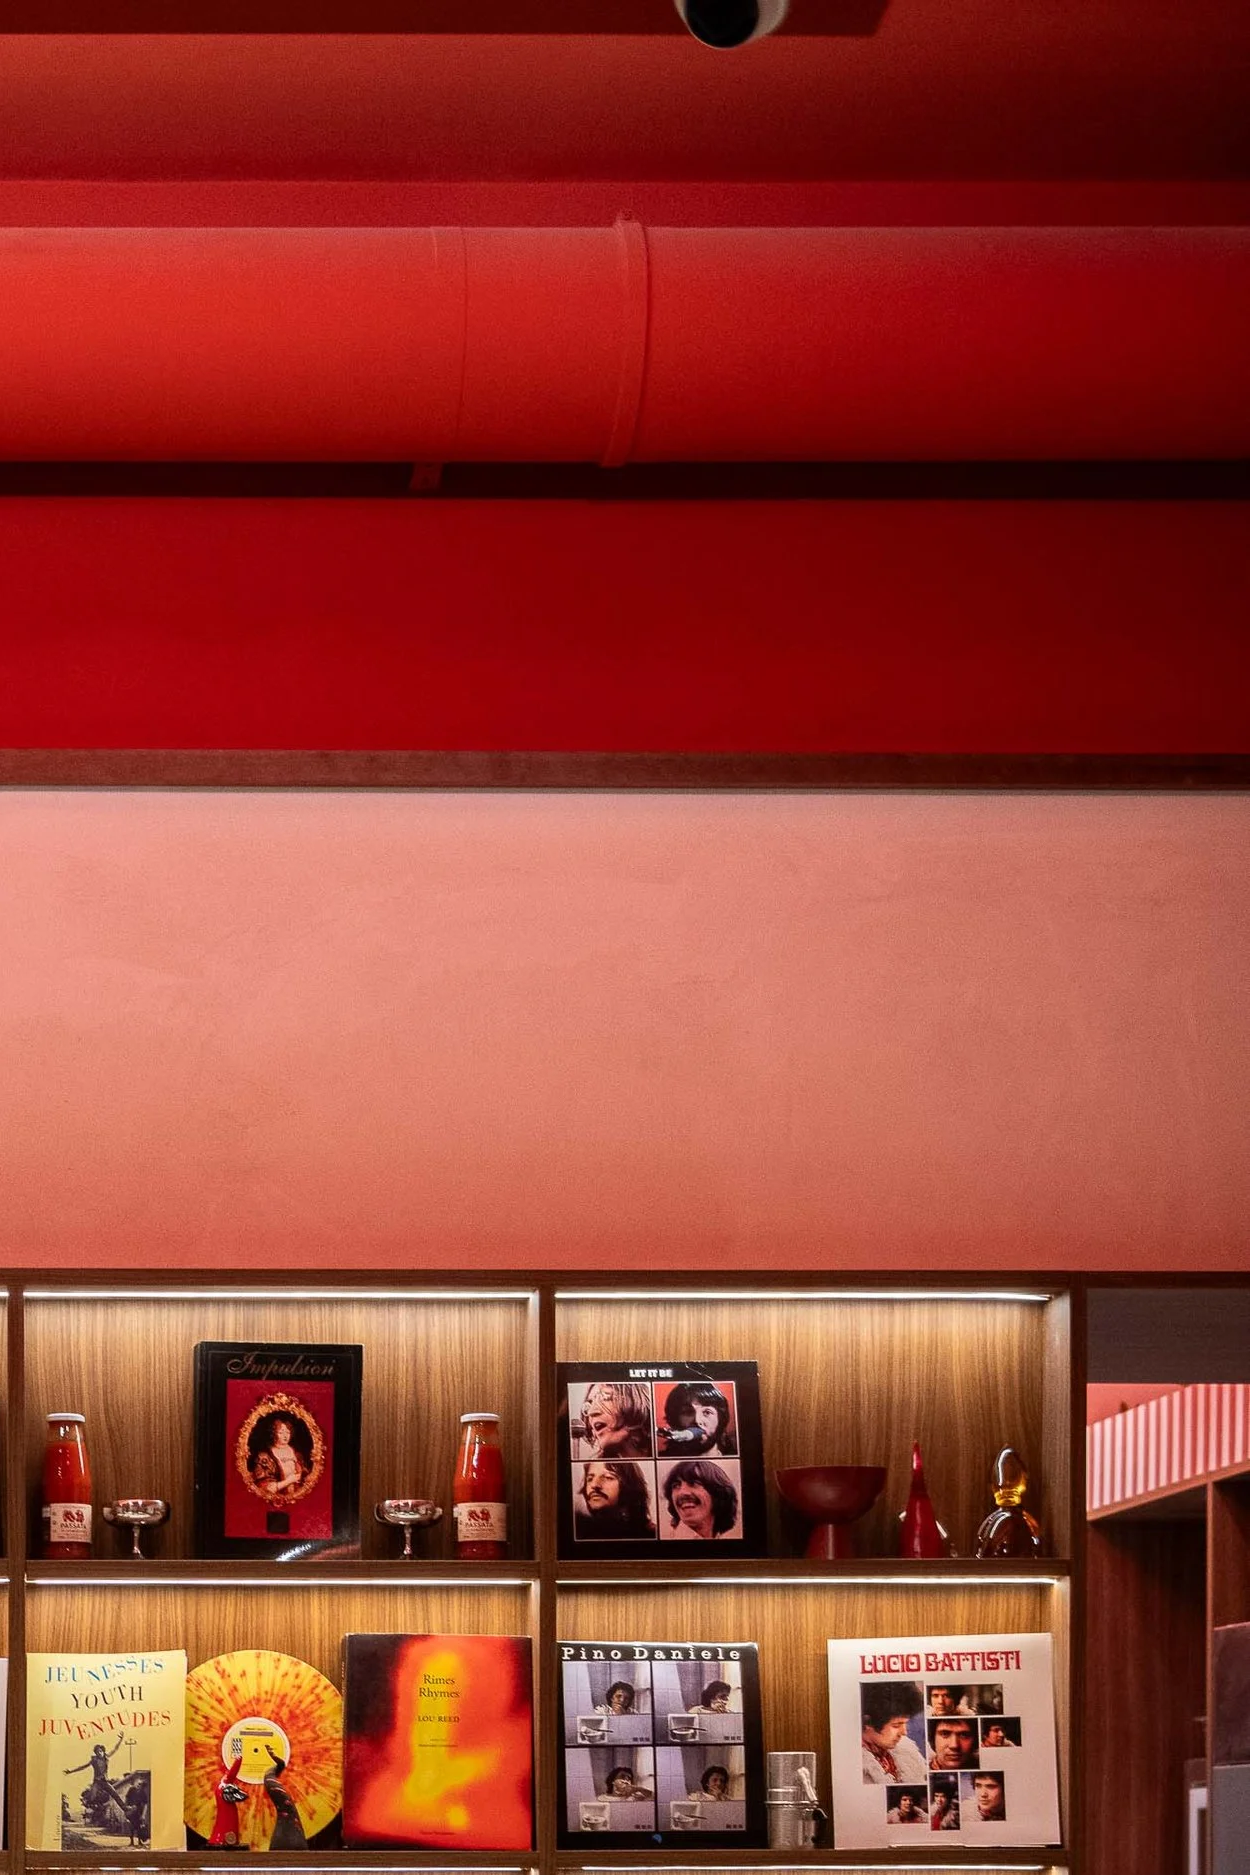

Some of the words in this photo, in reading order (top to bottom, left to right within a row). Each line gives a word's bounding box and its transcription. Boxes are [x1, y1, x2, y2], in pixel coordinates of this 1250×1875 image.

[629, 1369, 646, 1378] LET
[647, 1369, 658, 1378] IT
[659, 1369, 673, 1378] BE
[561, 1647, 622, 1660] Pino
[633, 1646, 740, 1660] Daniele
[860, 1653, 921, 1674] LUCIO
[924, 1650, 1022, 1672] BATTISTI
[44, 1656, 164, 1684] JEUNESSES
[423, 1674, 456, 1685] Rimes
[71, 1684, 144, 1709] YOUTH
[419, 1687, 460, 1701] Rhymes
[39, 1710, 171, 1740] JUVENTUDES
